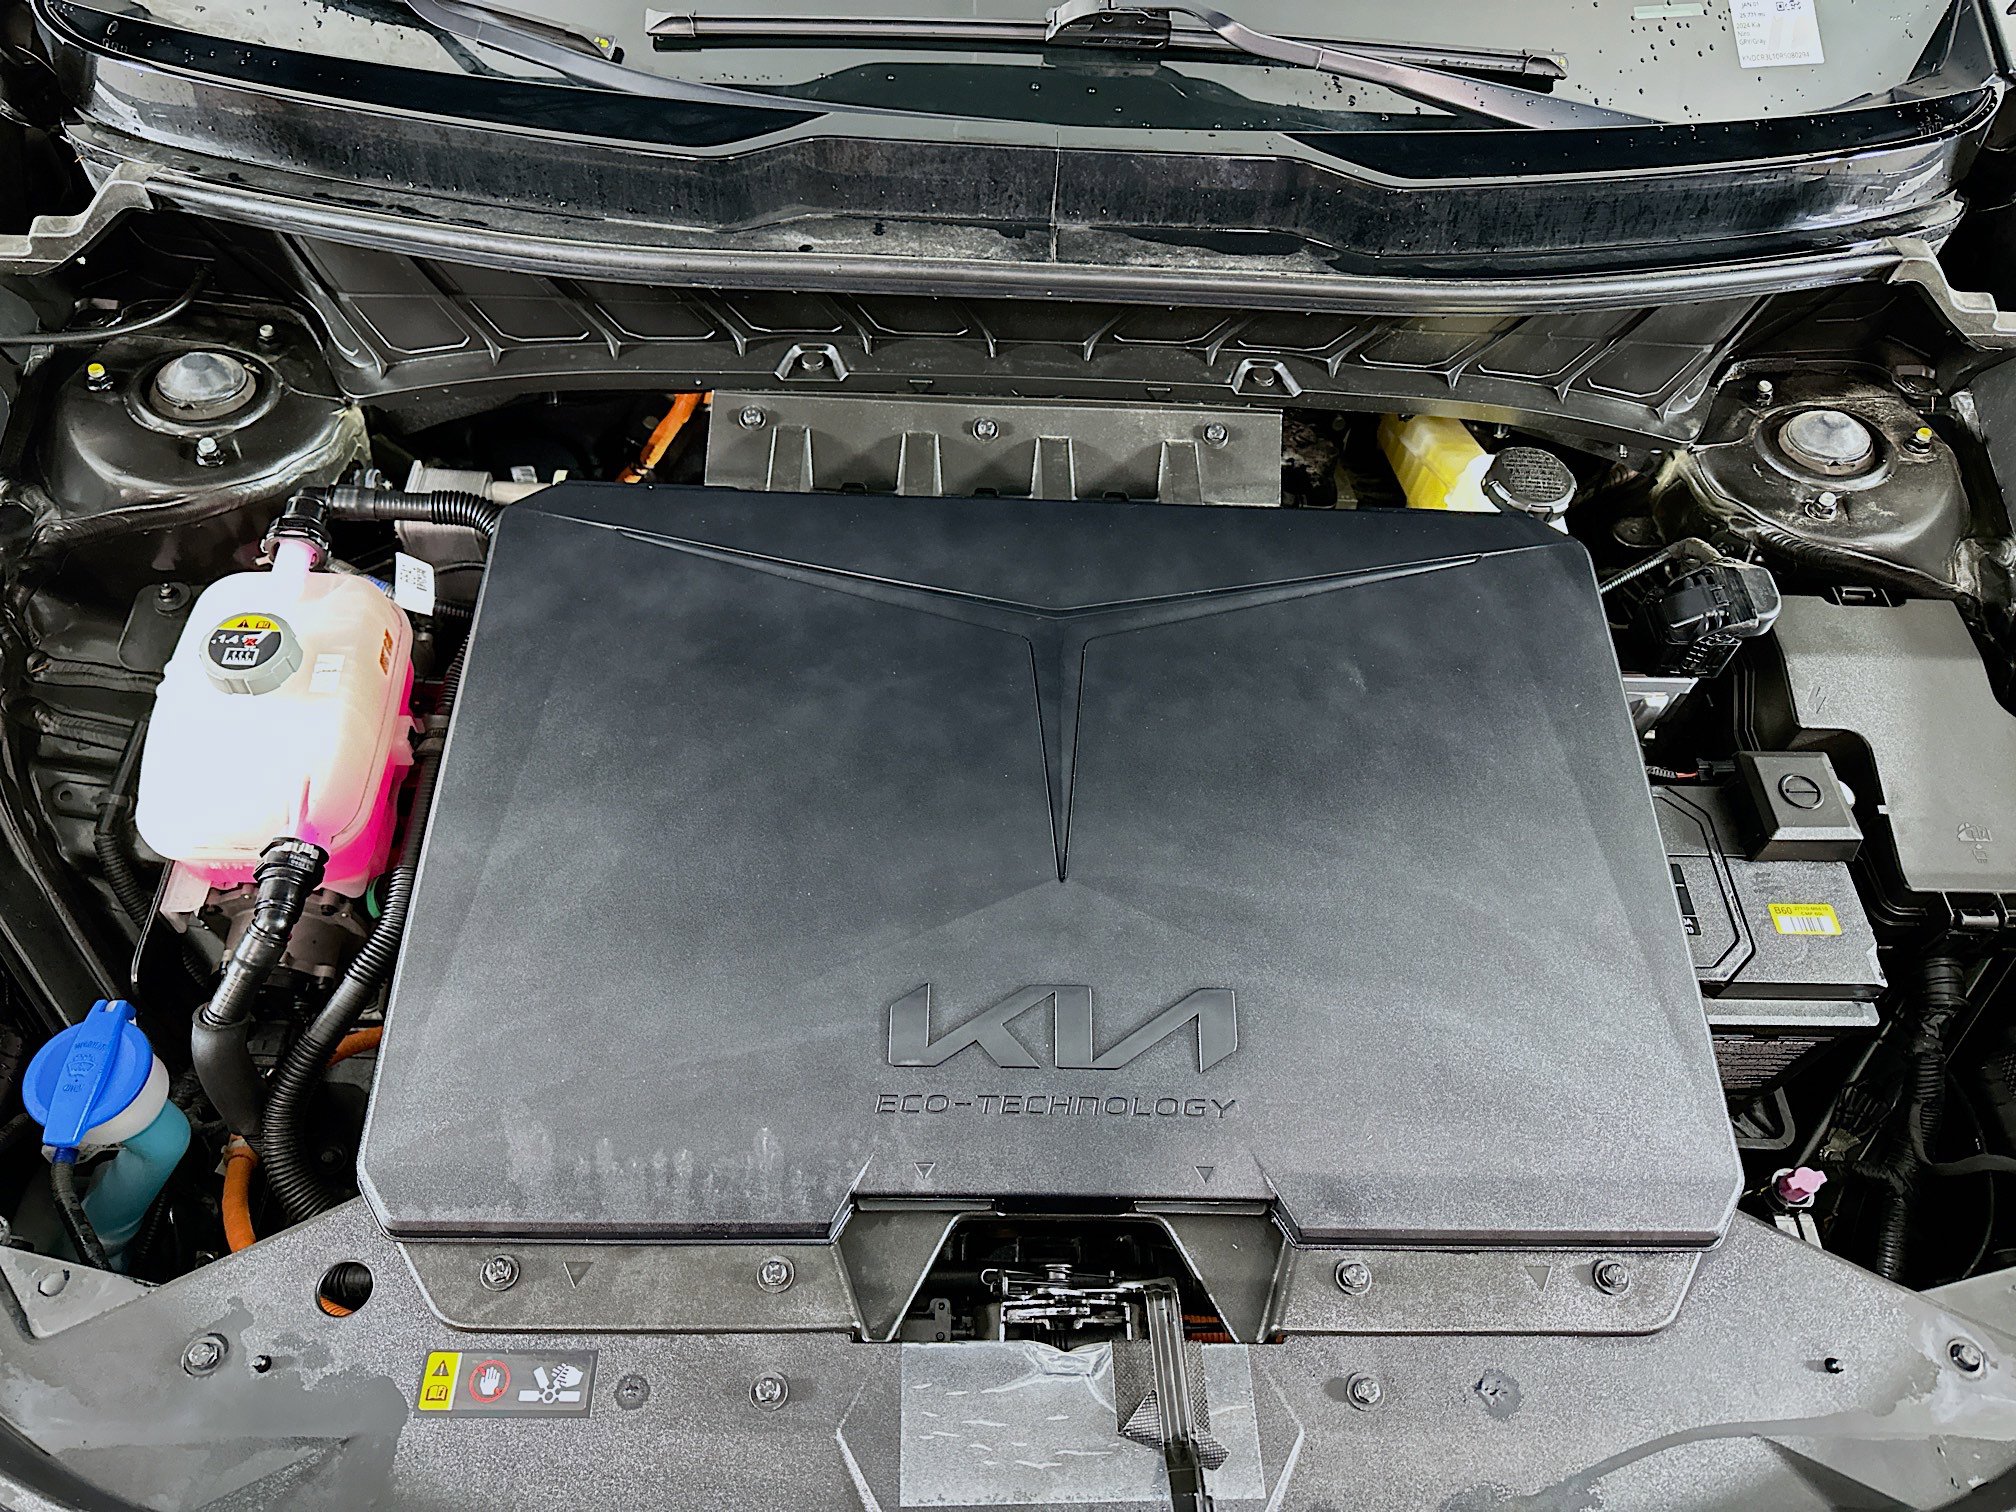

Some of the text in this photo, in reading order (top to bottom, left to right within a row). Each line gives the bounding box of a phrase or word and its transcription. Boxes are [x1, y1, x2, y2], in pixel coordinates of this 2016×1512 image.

[1773, 906, 1793, 915] B60
[887, 982, 1239, 1075] KIA
[874, 1094, 1236, 1119] ECO-TECHNOLOGY
